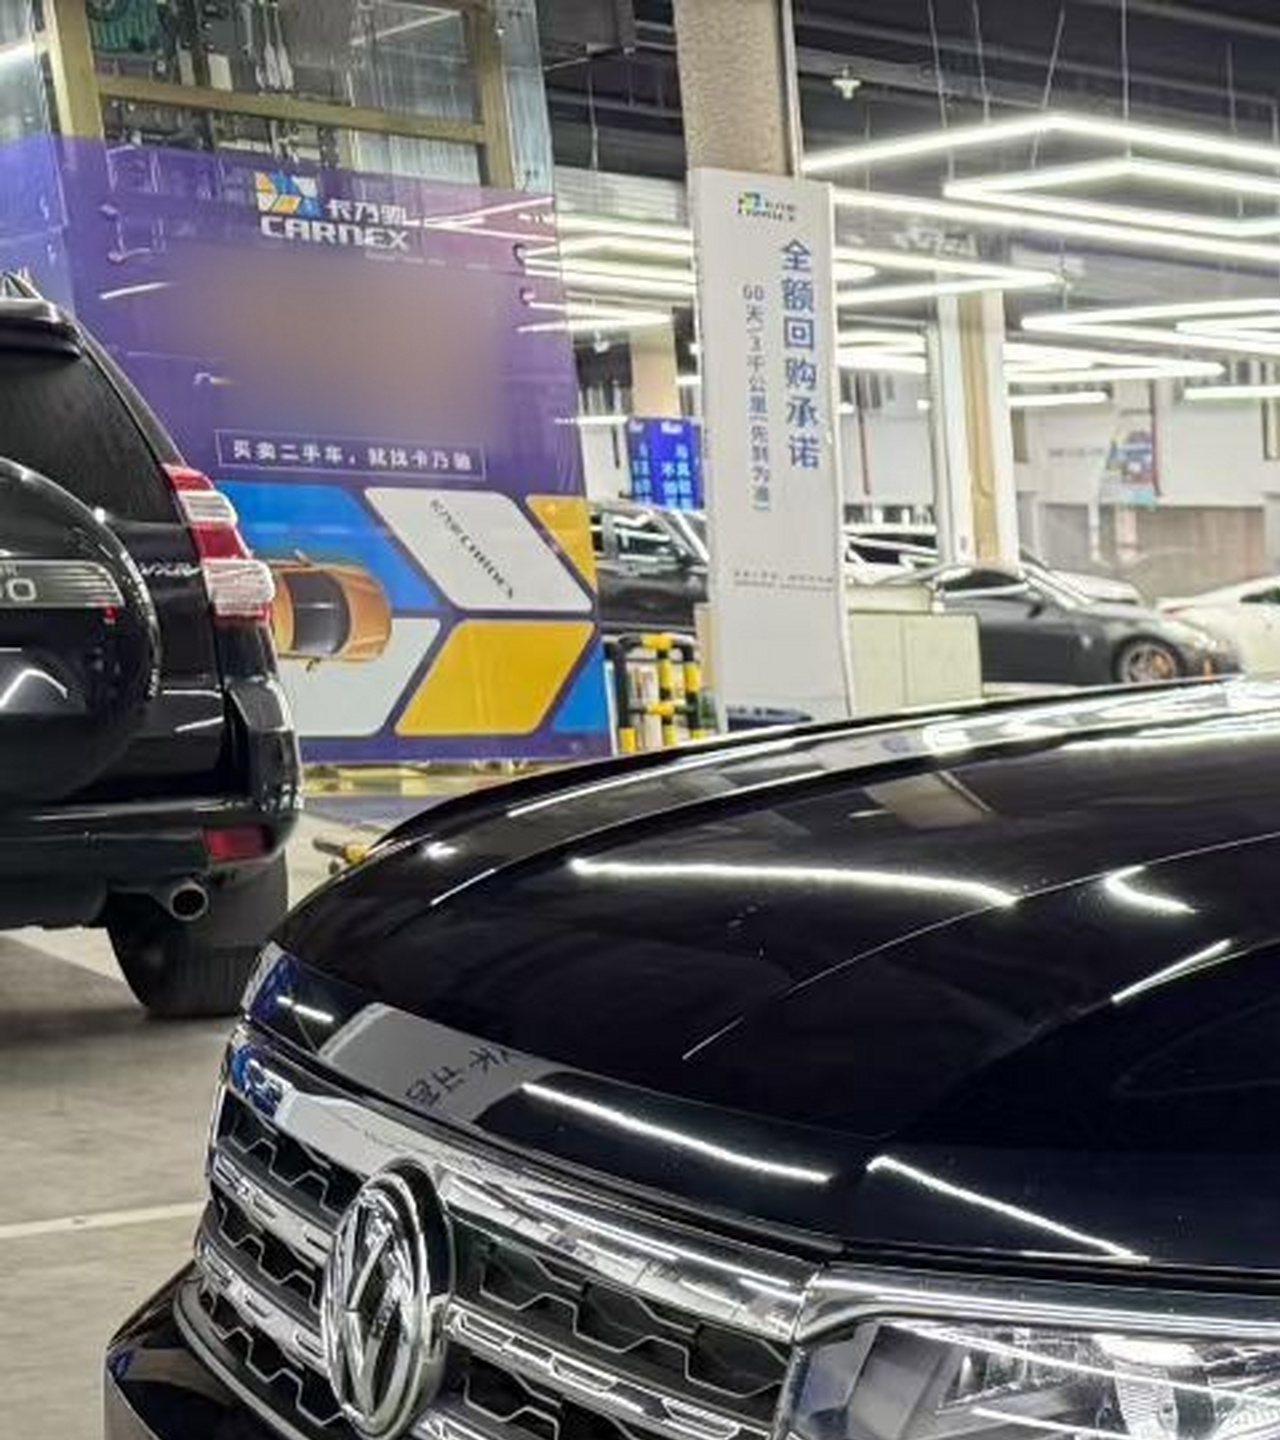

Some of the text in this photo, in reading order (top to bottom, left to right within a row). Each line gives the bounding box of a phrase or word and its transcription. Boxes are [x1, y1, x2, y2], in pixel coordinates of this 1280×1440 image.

[260, 215, 409, 250] CARNEX
[781, 238, 820, 470] 全额回购承诺
